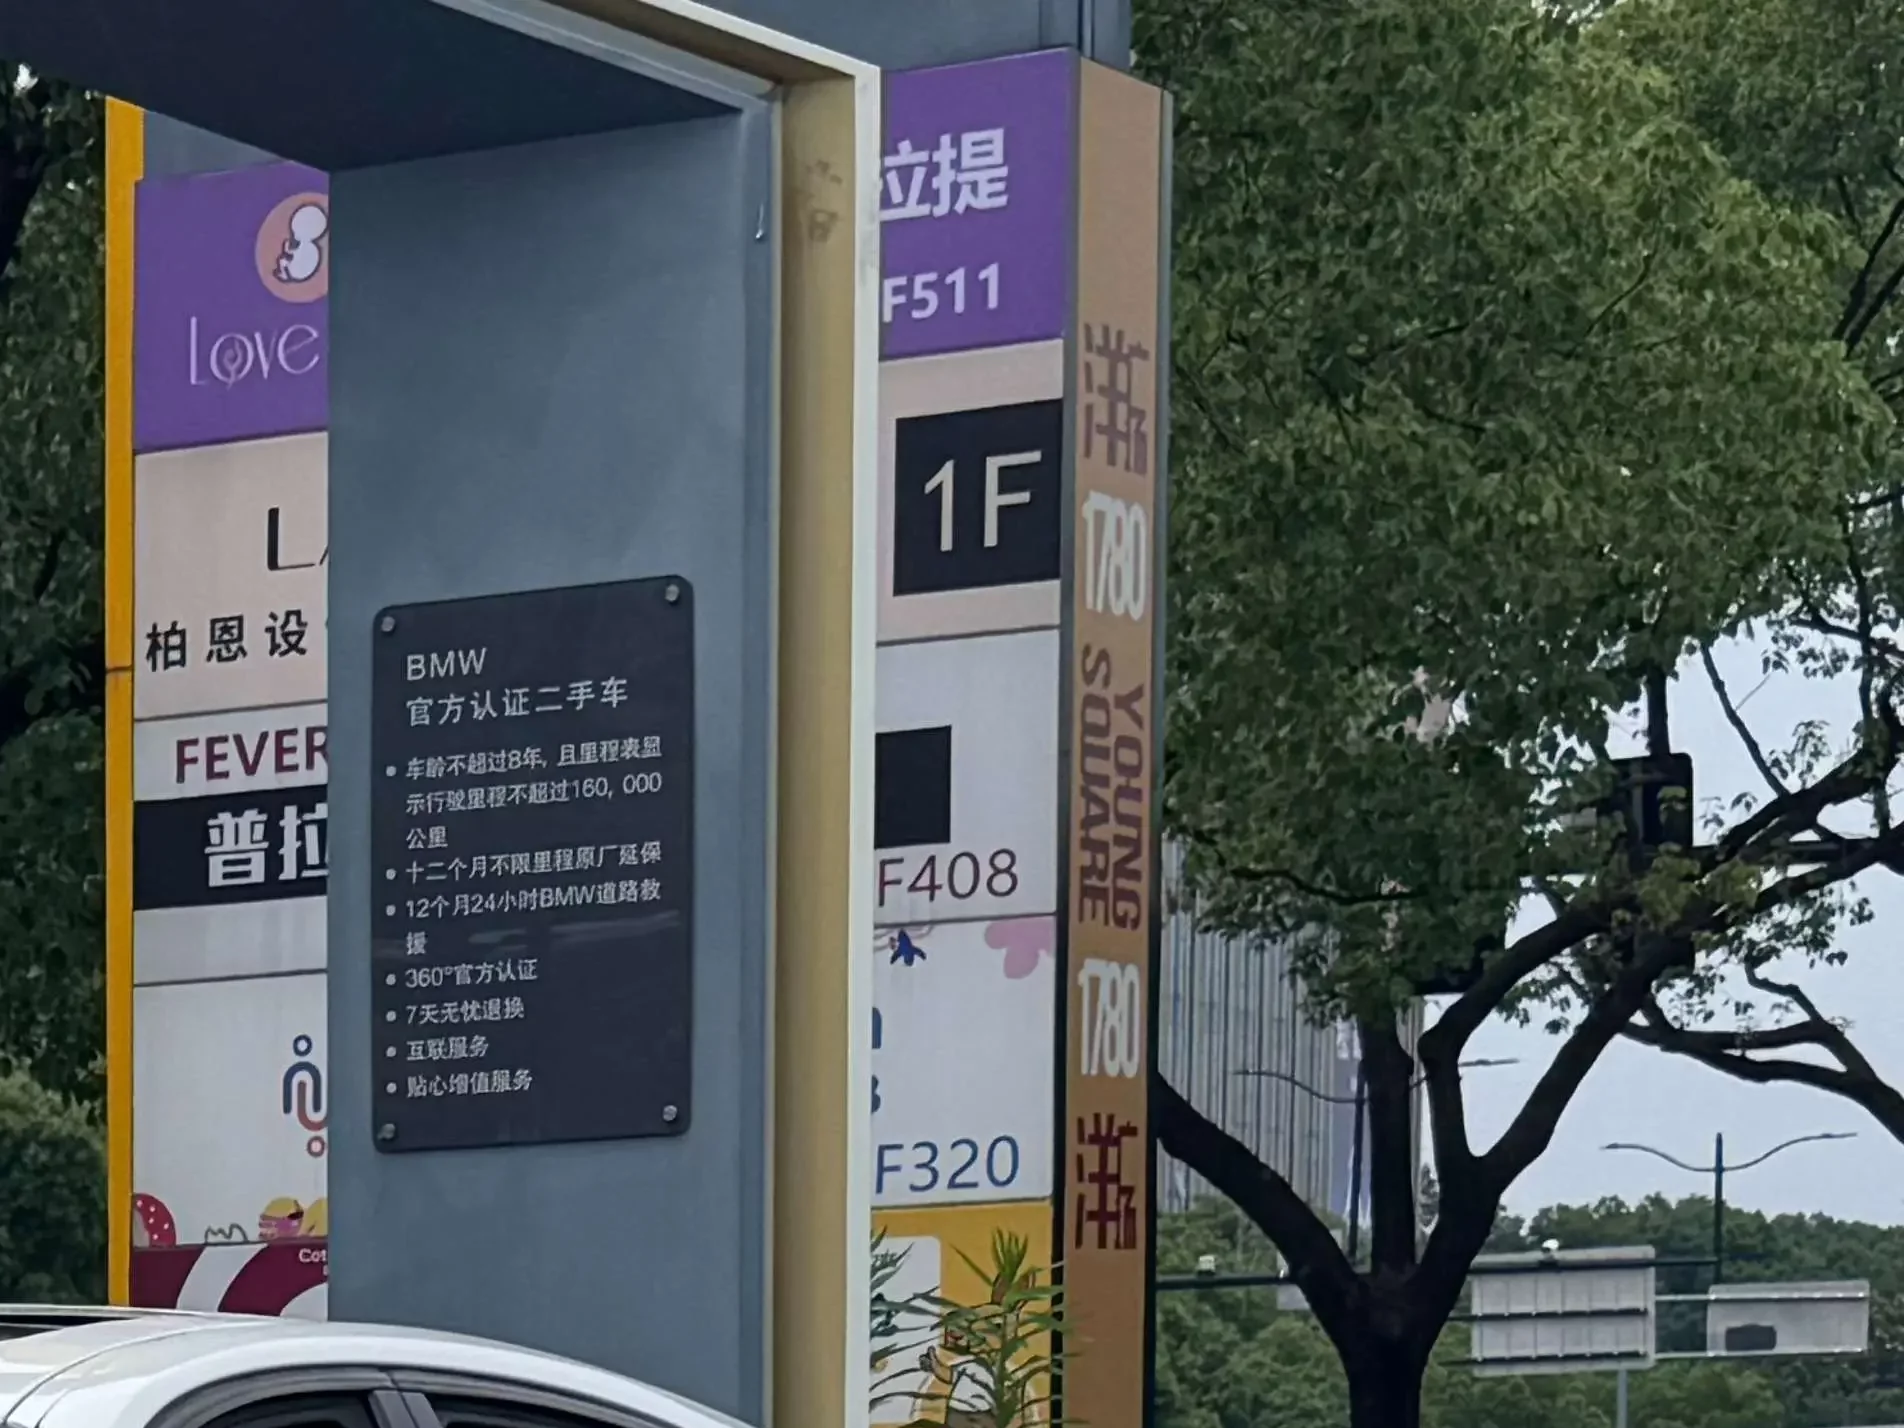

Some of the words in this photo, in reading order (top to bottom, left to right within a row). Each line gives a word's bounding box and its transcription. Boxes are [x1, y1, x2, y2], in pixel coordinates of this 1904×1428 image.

[882, 262, 999, 323] F511
[924, 450, 1042, 552] 1F
[1082, 488, 1147, 622] 1780
[145, 608, 309, 673] 柏恩设
[406, 647, 487, 682] BMW
[406, 676, 629, 726] 官方认证二手车
[1078, 642, 1111, 927] SQUARE
[1113, 683, 1144, 931] YOUNG
[406, 825, 448, 850] 公里
[877, 848, 1019, 908] F408
[1077, 957, 1140, 1078] 1780
[875, 1134, 1020, 1195] F320
